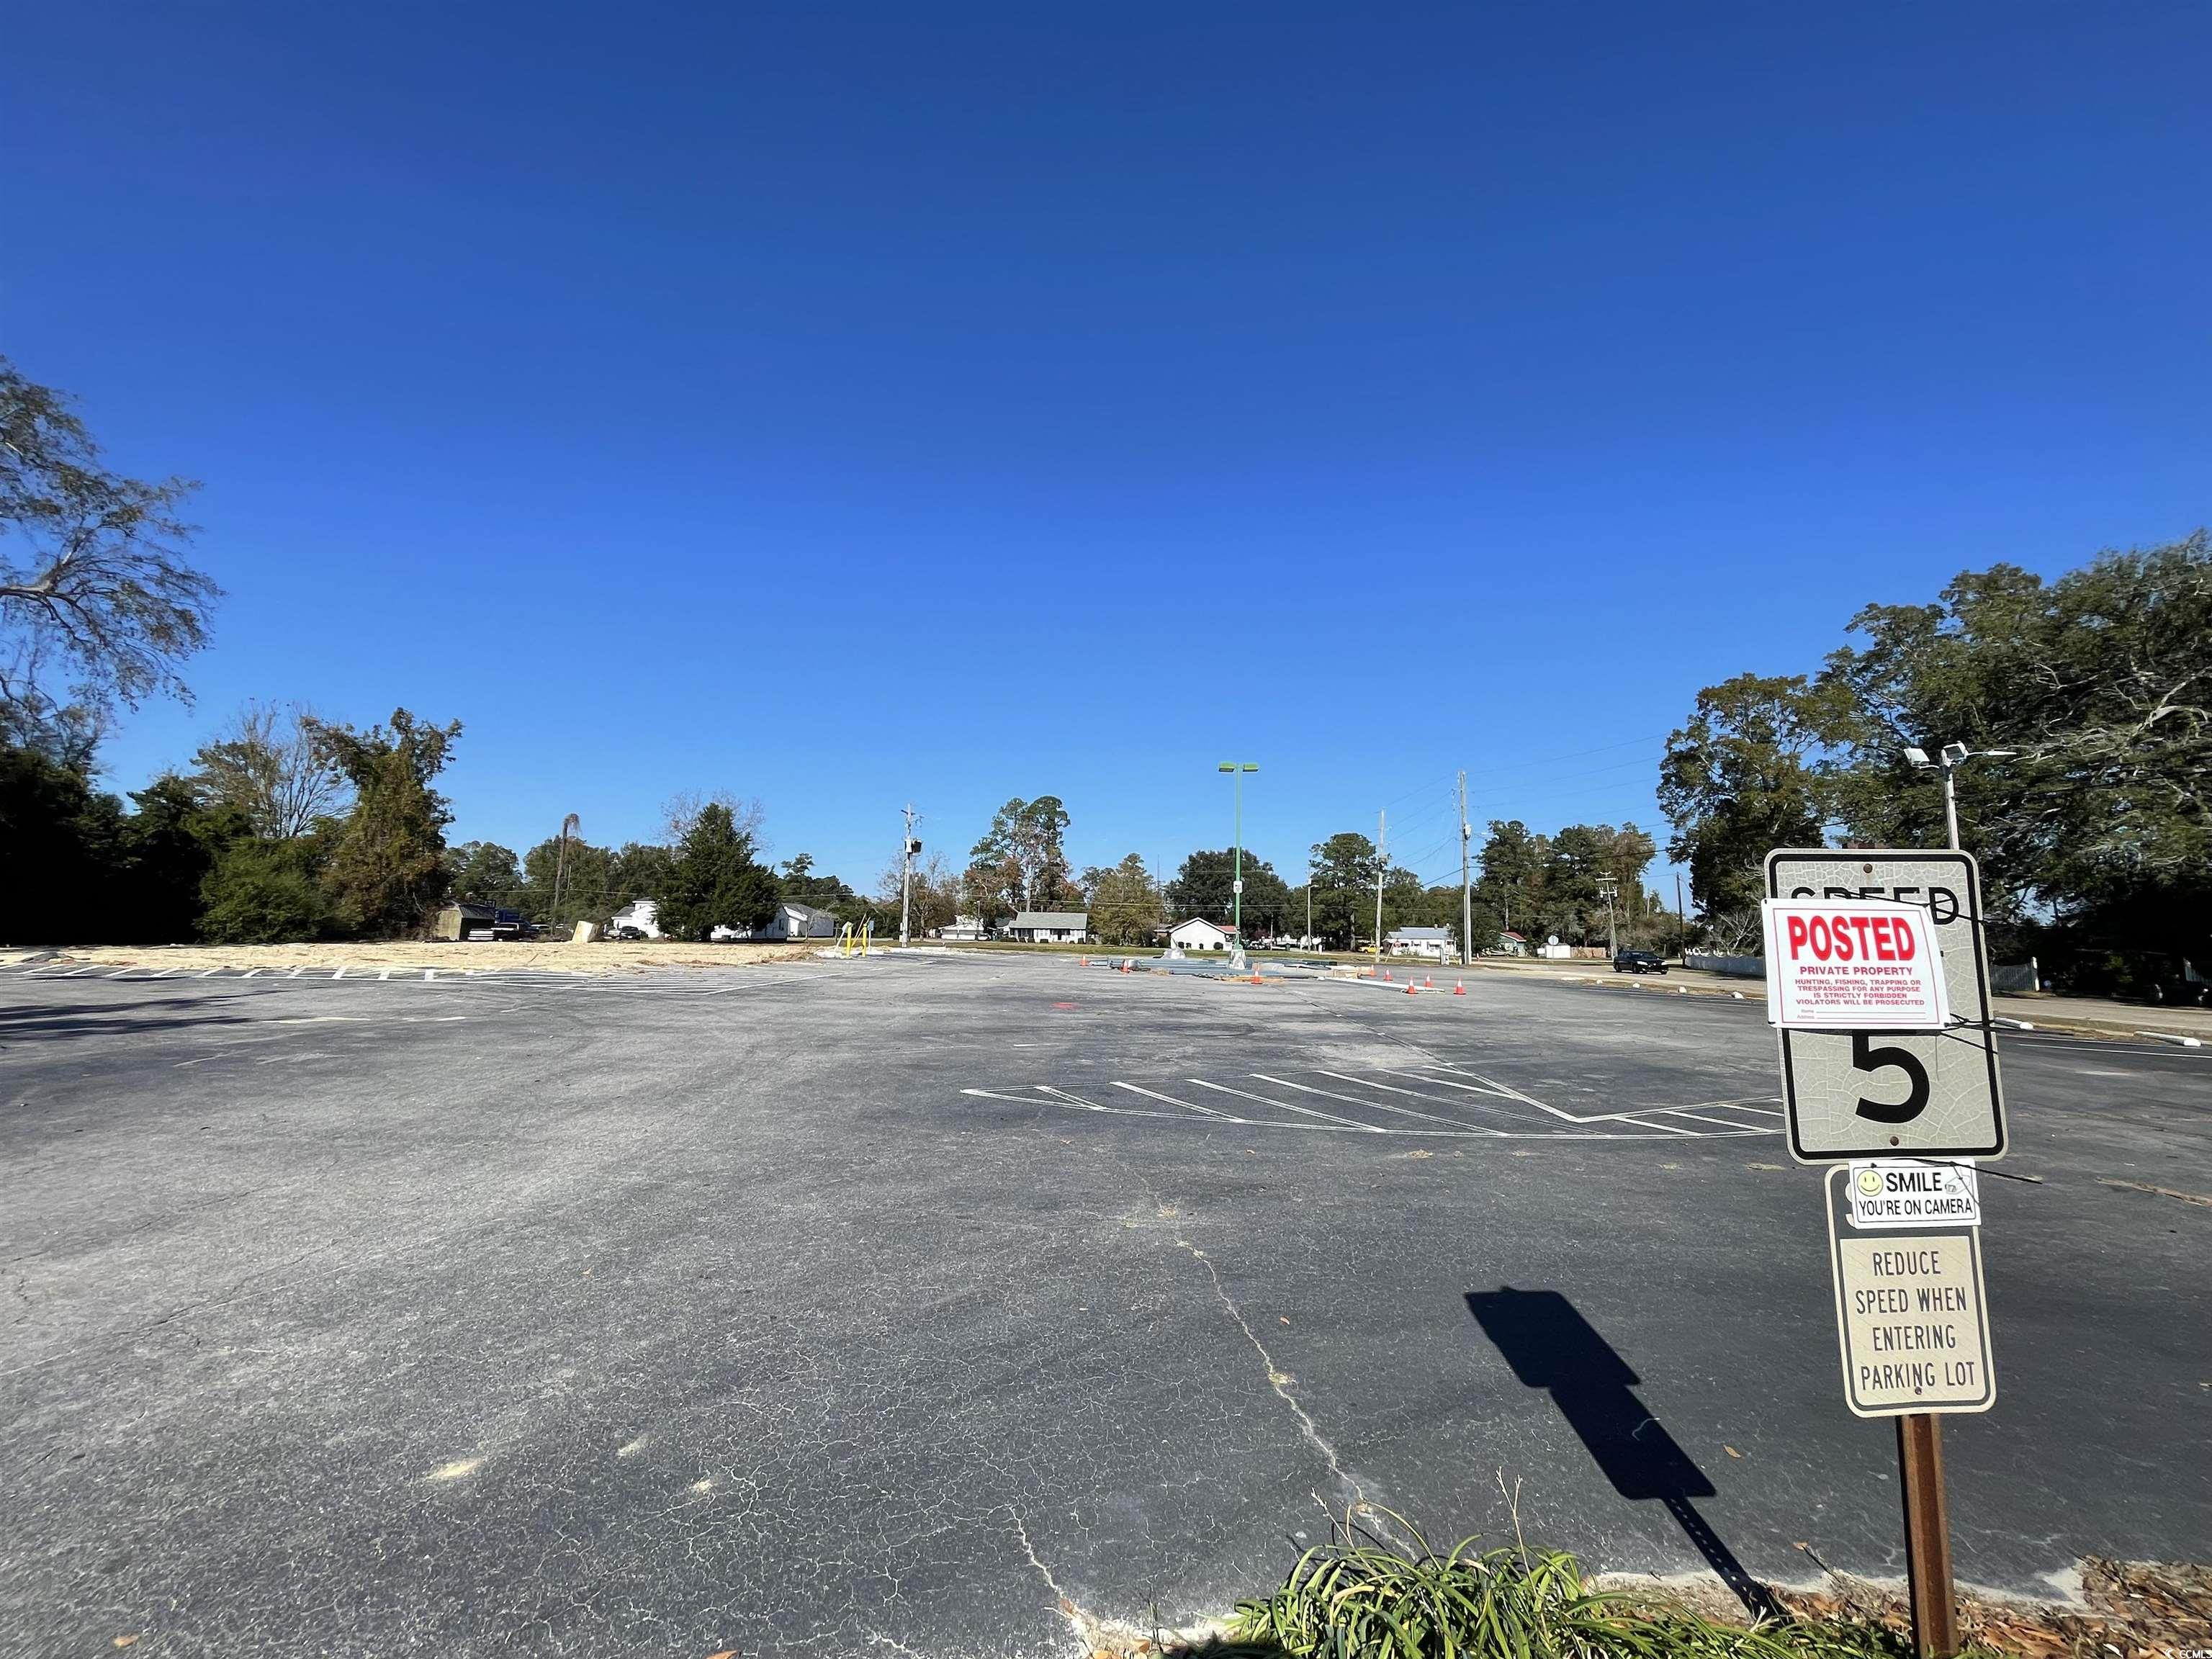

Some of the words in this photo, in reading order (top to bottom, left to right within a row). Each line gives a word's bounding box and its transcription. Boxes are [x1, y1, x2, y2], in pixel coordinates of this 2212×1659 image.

[1787, 915, 1915, 961] POSTED
[1799, 966, 1850, 975] PRIVATE
[1853, 966, 1912, 976] PROPERTY
[1852, 1030, 1930, 1124] 5
[1886, 1172, 1942, 1192] SMILE
[1858, 1199, 1901, 1216] YOU'RE
[1905, 1200, 1922, 1215] ON
[1925, 1197, 1973, 1215] CAMERA
[1873, 1251, 1941, 1276] REDUCE
[1855, 1288, 1908, 1314] SPEED
[1917, 1287, 1967, 1312] WHEN
[1873, 1324, 1956, 1352] ENTERING
[1861, 1362, 1936, 1390] PARKING
[1945, 1362, 1975, 1386] LOT
